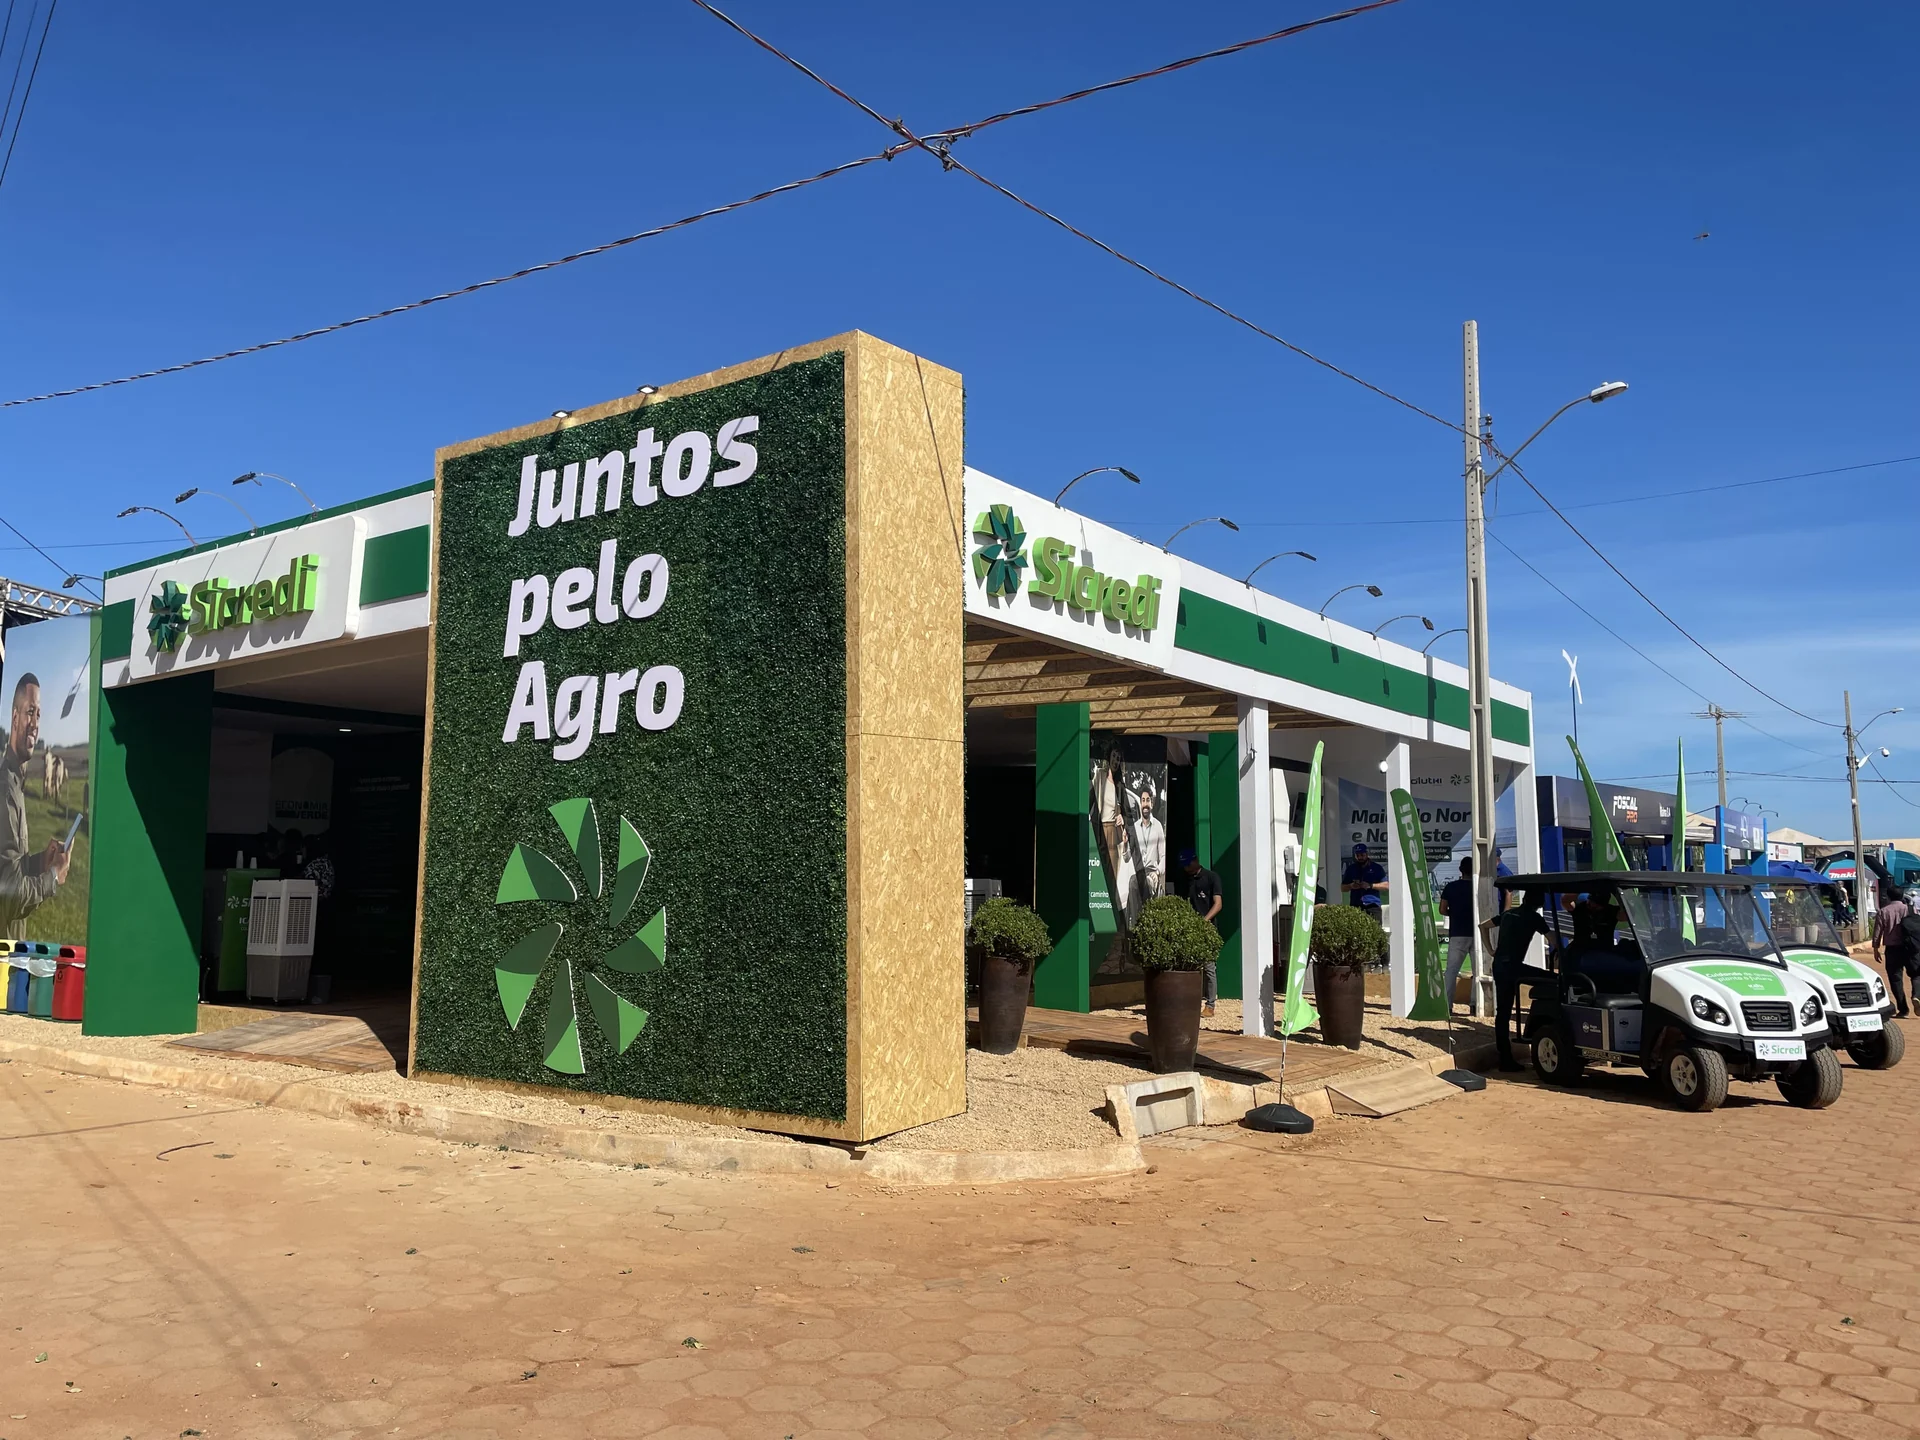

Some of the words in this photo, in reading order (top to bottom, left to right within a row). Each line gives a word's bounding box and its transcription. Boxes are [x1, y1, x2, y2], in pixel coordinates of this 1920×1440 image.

[507, 415, 760, 537] Juntos
[188, 554, 320, 635] Sicredi
[503, 538, 669, 658] pelo
[1028, 537, 1162, 630] Sicredi
[502, 660, 685, 761] Agro
[1351, 809, 1387, 824] Mai
[1435, 808, 1472, 823] Nor
[1352, 832, 1363, 843] e
[1771, 1045, 1803, 1054] Sicredi
[1857, 1018, 1880, 1027] Sicredi
